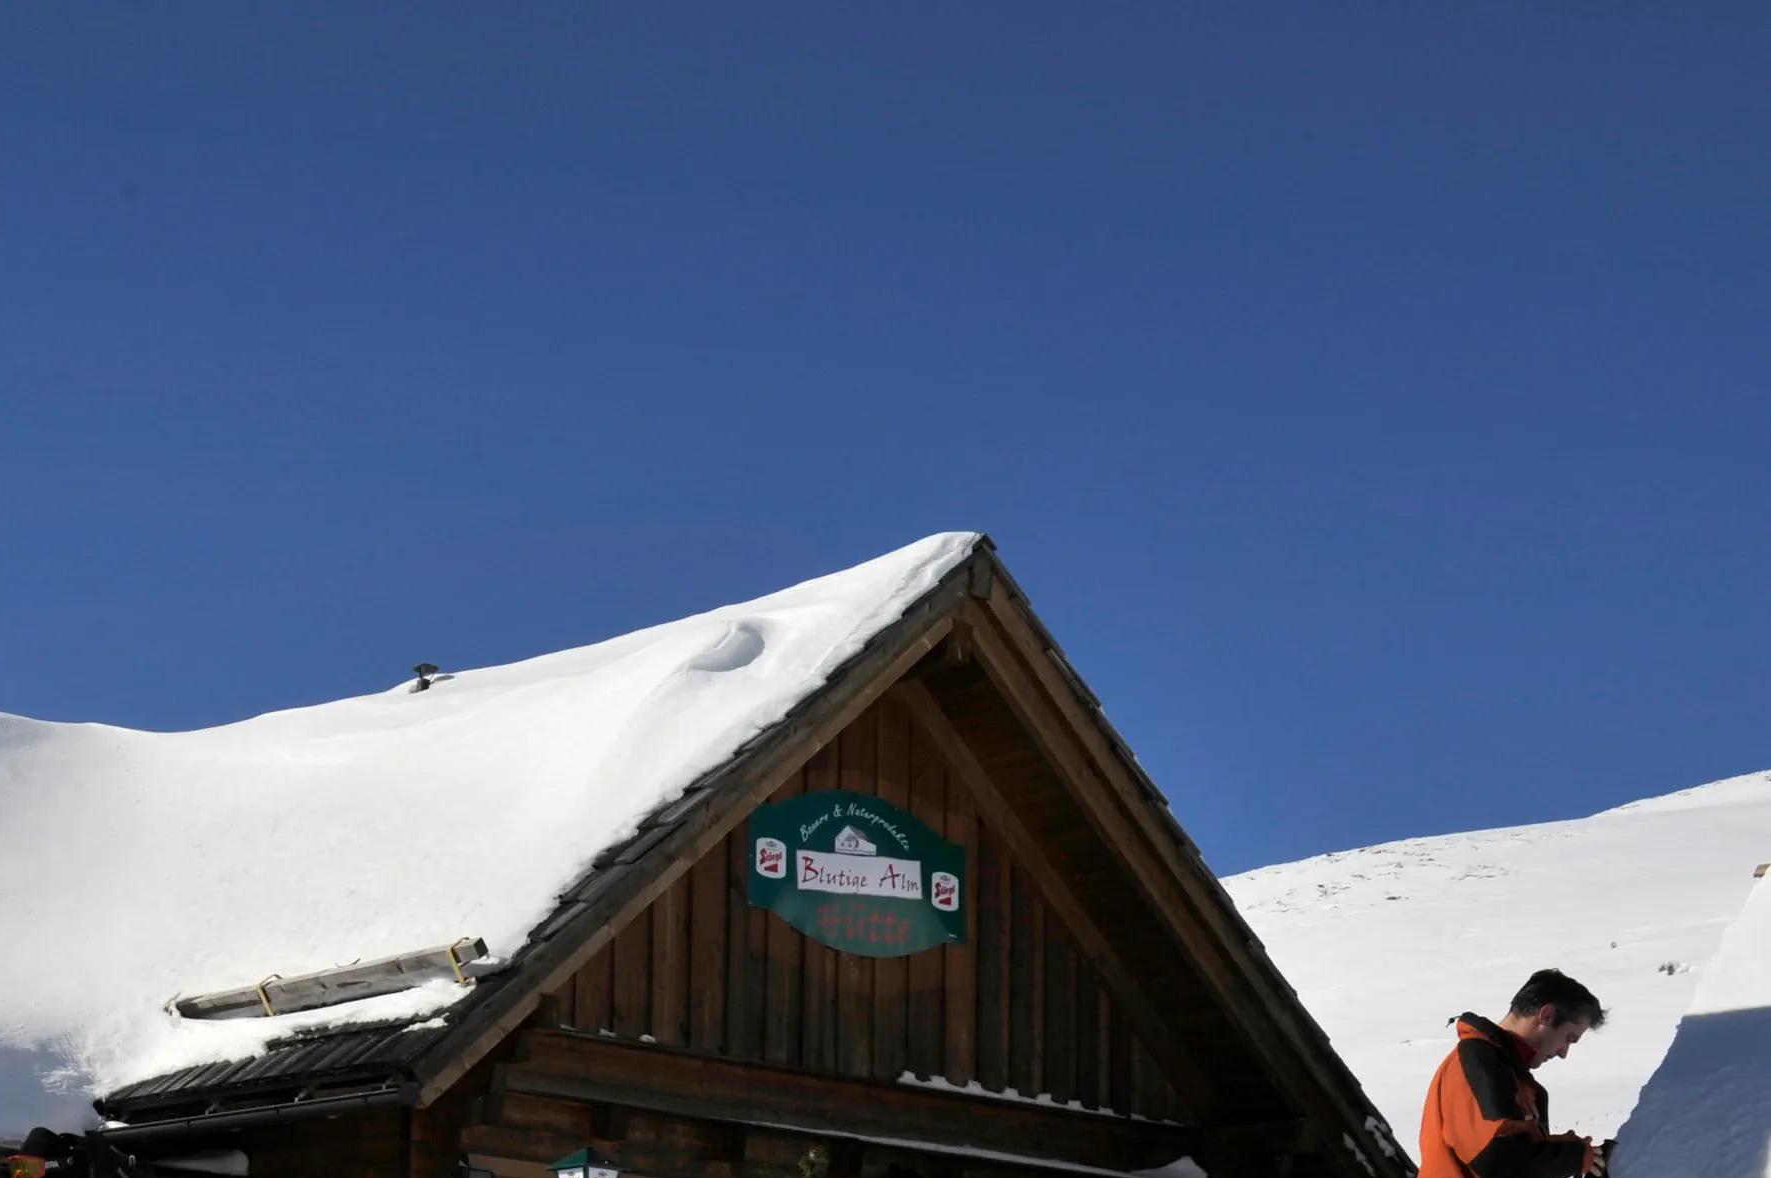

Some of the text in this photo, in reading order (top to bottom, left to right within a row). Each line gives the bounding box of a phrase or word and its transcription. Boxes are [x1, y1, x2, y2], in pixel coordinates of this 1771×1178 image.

[833, 803, 843, 818] &
[759, 847, 783, 865] Stiegl
[801, 856, 921, 893] Blutige Alm
[934, 881, 956, 899] Stiegl
[817, 902, 912, 943] Hütte
